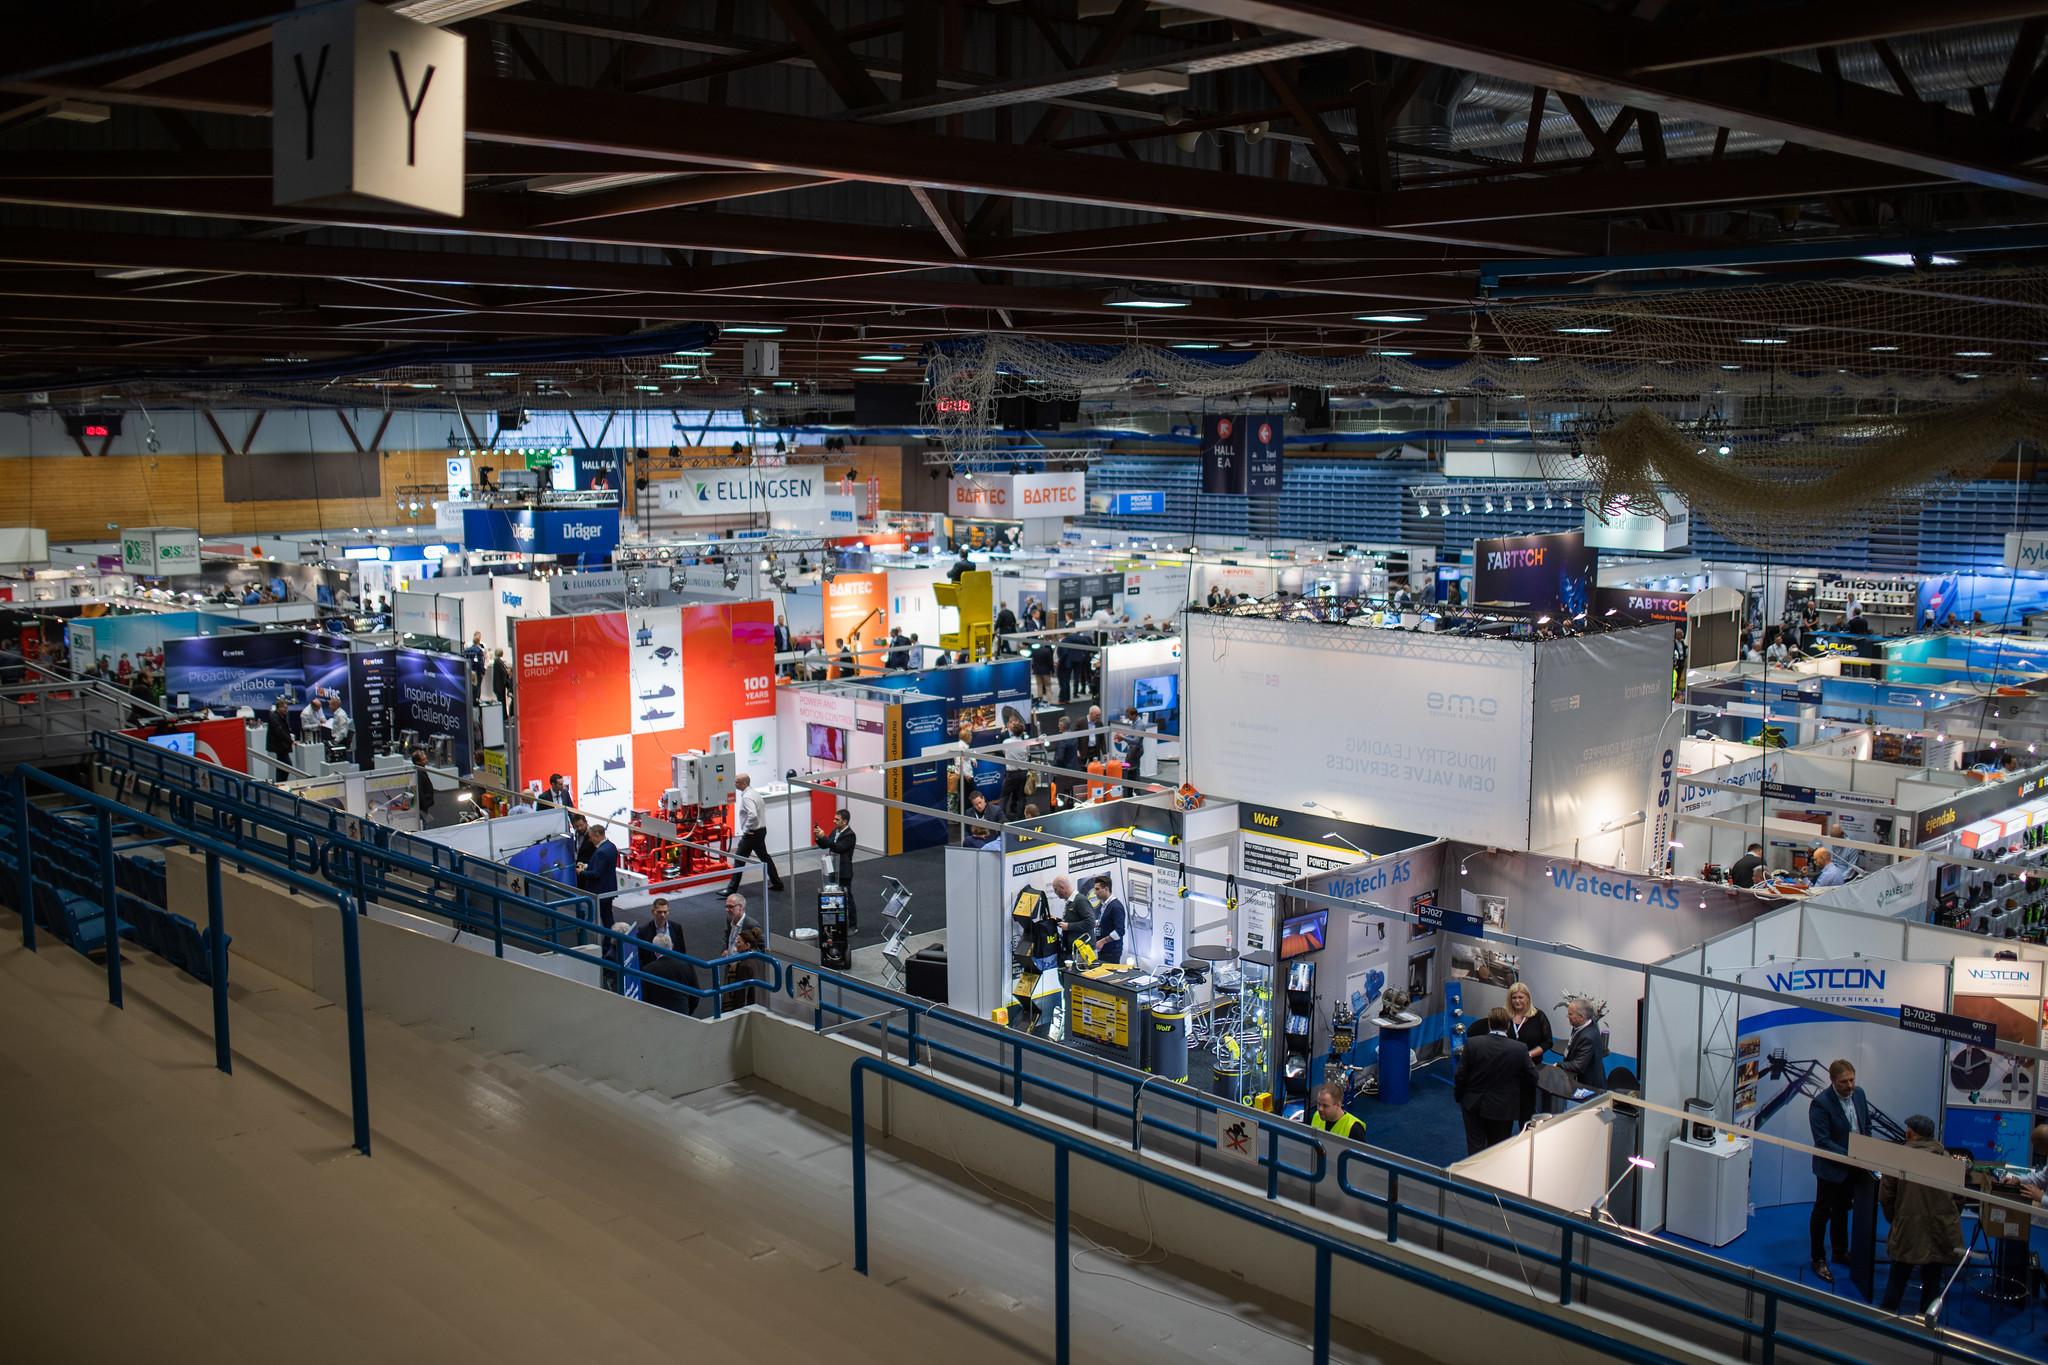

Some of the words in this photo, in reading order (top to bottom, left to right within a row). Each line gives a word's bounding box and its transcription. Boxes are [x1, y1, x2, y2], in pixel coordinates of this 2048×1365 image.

[294, 44, 331, 160] Y
[389, 49, 436, 167] Y
[1214, 445, 1235, 456] HALL
[582, 461, 599, 470] HALL
[717, 479, 812, 500] ELLINGSEN
[956, 487, 1006, 505] BARTEC
[1023, 486, 1076, 505] BARTEC
[563, 523, 602, 541] Dräger
[1487, 547, 1544, 571] FABTECH
[2022, 542, 2048, 565] xyl
[829, 581, 873, 597] BARTEC
[502, 591, 523, 608] Dräger
[523, 650, 568, 668] SERVI
[188, 670, 246, 683] Proactive
[229, 678, 275, 691] reliable
[744, 675, 769, 690] 100
[404, 683, 438, 705] Inspired
[440, 692, 451, 711] by
[745, 690, 769, 700] YEARS
[411, 704, 460, 730] Challenges
[1658, 749, 1674, 808] OPS
[1681, 785, 1696, 802] JD
[1685, 802, 1701, 812] TESS
[1253, 812, 1279, 828] Wolf
[1926, 808, 1957, 833] ejendals
[1026, 858, 1056, 873] VENTILATION
[1308, 857, 1328, 869] POWER
[1328, 866, 1387, 898] Watech
[1391, 860, 1411, 884] AS
[1551, 867, 1638, 900] Watech
[1647, 885, 1680, 910] AS
[1420, 906, 1443, 918] B-7027
[1766, 968, 1886, 992] WESTCON
[1968, 968, 2030, 981] WESTCON
[1903, 1007, 1936, 1022] B-7025
[1155, 1022, 1172, 1032] Wolf
[1903, 1020, 1930, 1031] WESTCON
